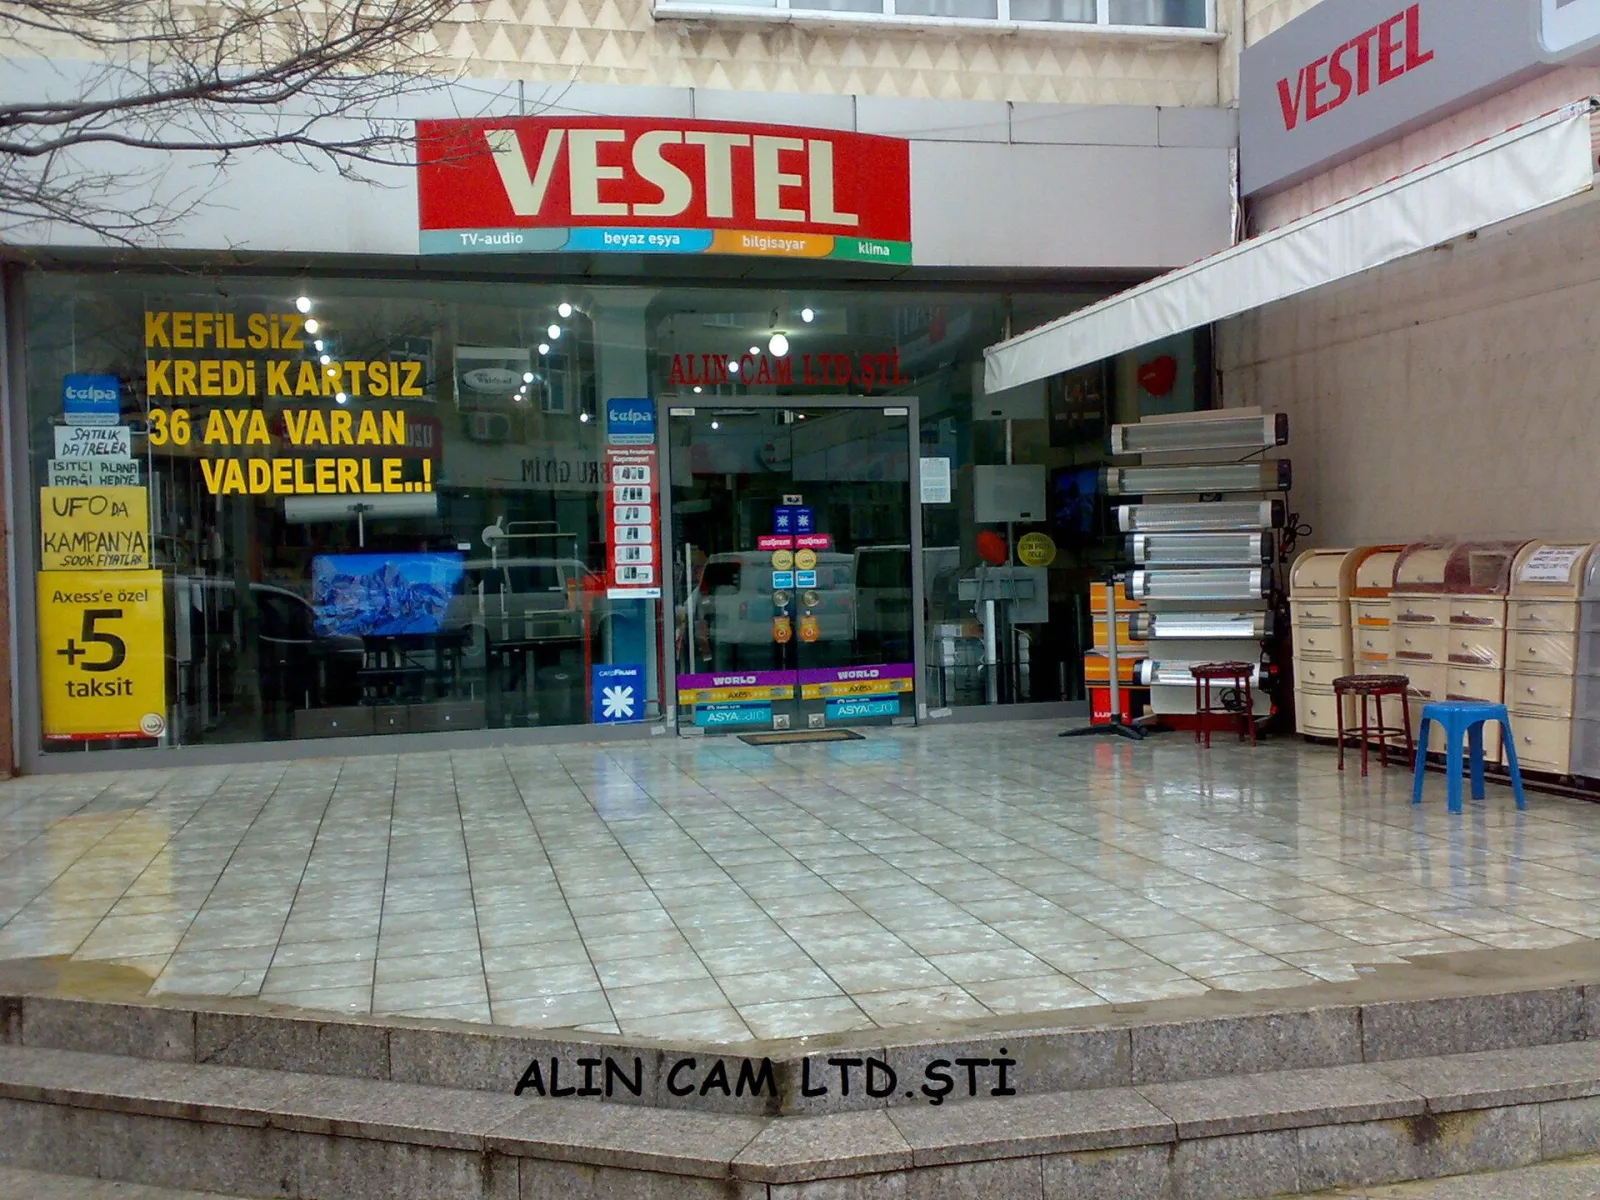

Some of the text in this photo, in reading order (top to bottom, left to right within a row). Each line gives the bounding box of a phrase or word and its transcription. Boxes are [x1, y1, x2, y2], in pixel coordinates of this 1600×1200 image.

[1276, 2, 1434, 132] VESTEL
[484, 129, 858, 227] VESTEL
[460, 232, 523, 245] TV-audio
[604, 232, 681, 248] beyaz eşya
[742, 236, 806, 253] bilgisayar
[858, 242, 890, 256] klima
[670, 354, 729, 385] ALIN
[739, 355, 795, 385] CAM
[267, 361, 423, 397] KARTSIZ
[70, 428, 121, 441] SATILIK
[150, 408, 190, 446] 36
[204, 409, 271, 445] AYA
[283, 409, 406, 445] VARAN
[101, 462, 137, 473] ALANA
[200, 458, 432, 494] VADELERLE..!
[44, 531, 146, 553] KAMPANYA
[52, 589, 148, 604] Axess'e özel
[712, 675, 757, 686] WORLD
[837, 669, 880, 680] WORLD
[65, 677, 133, 698] taksit
